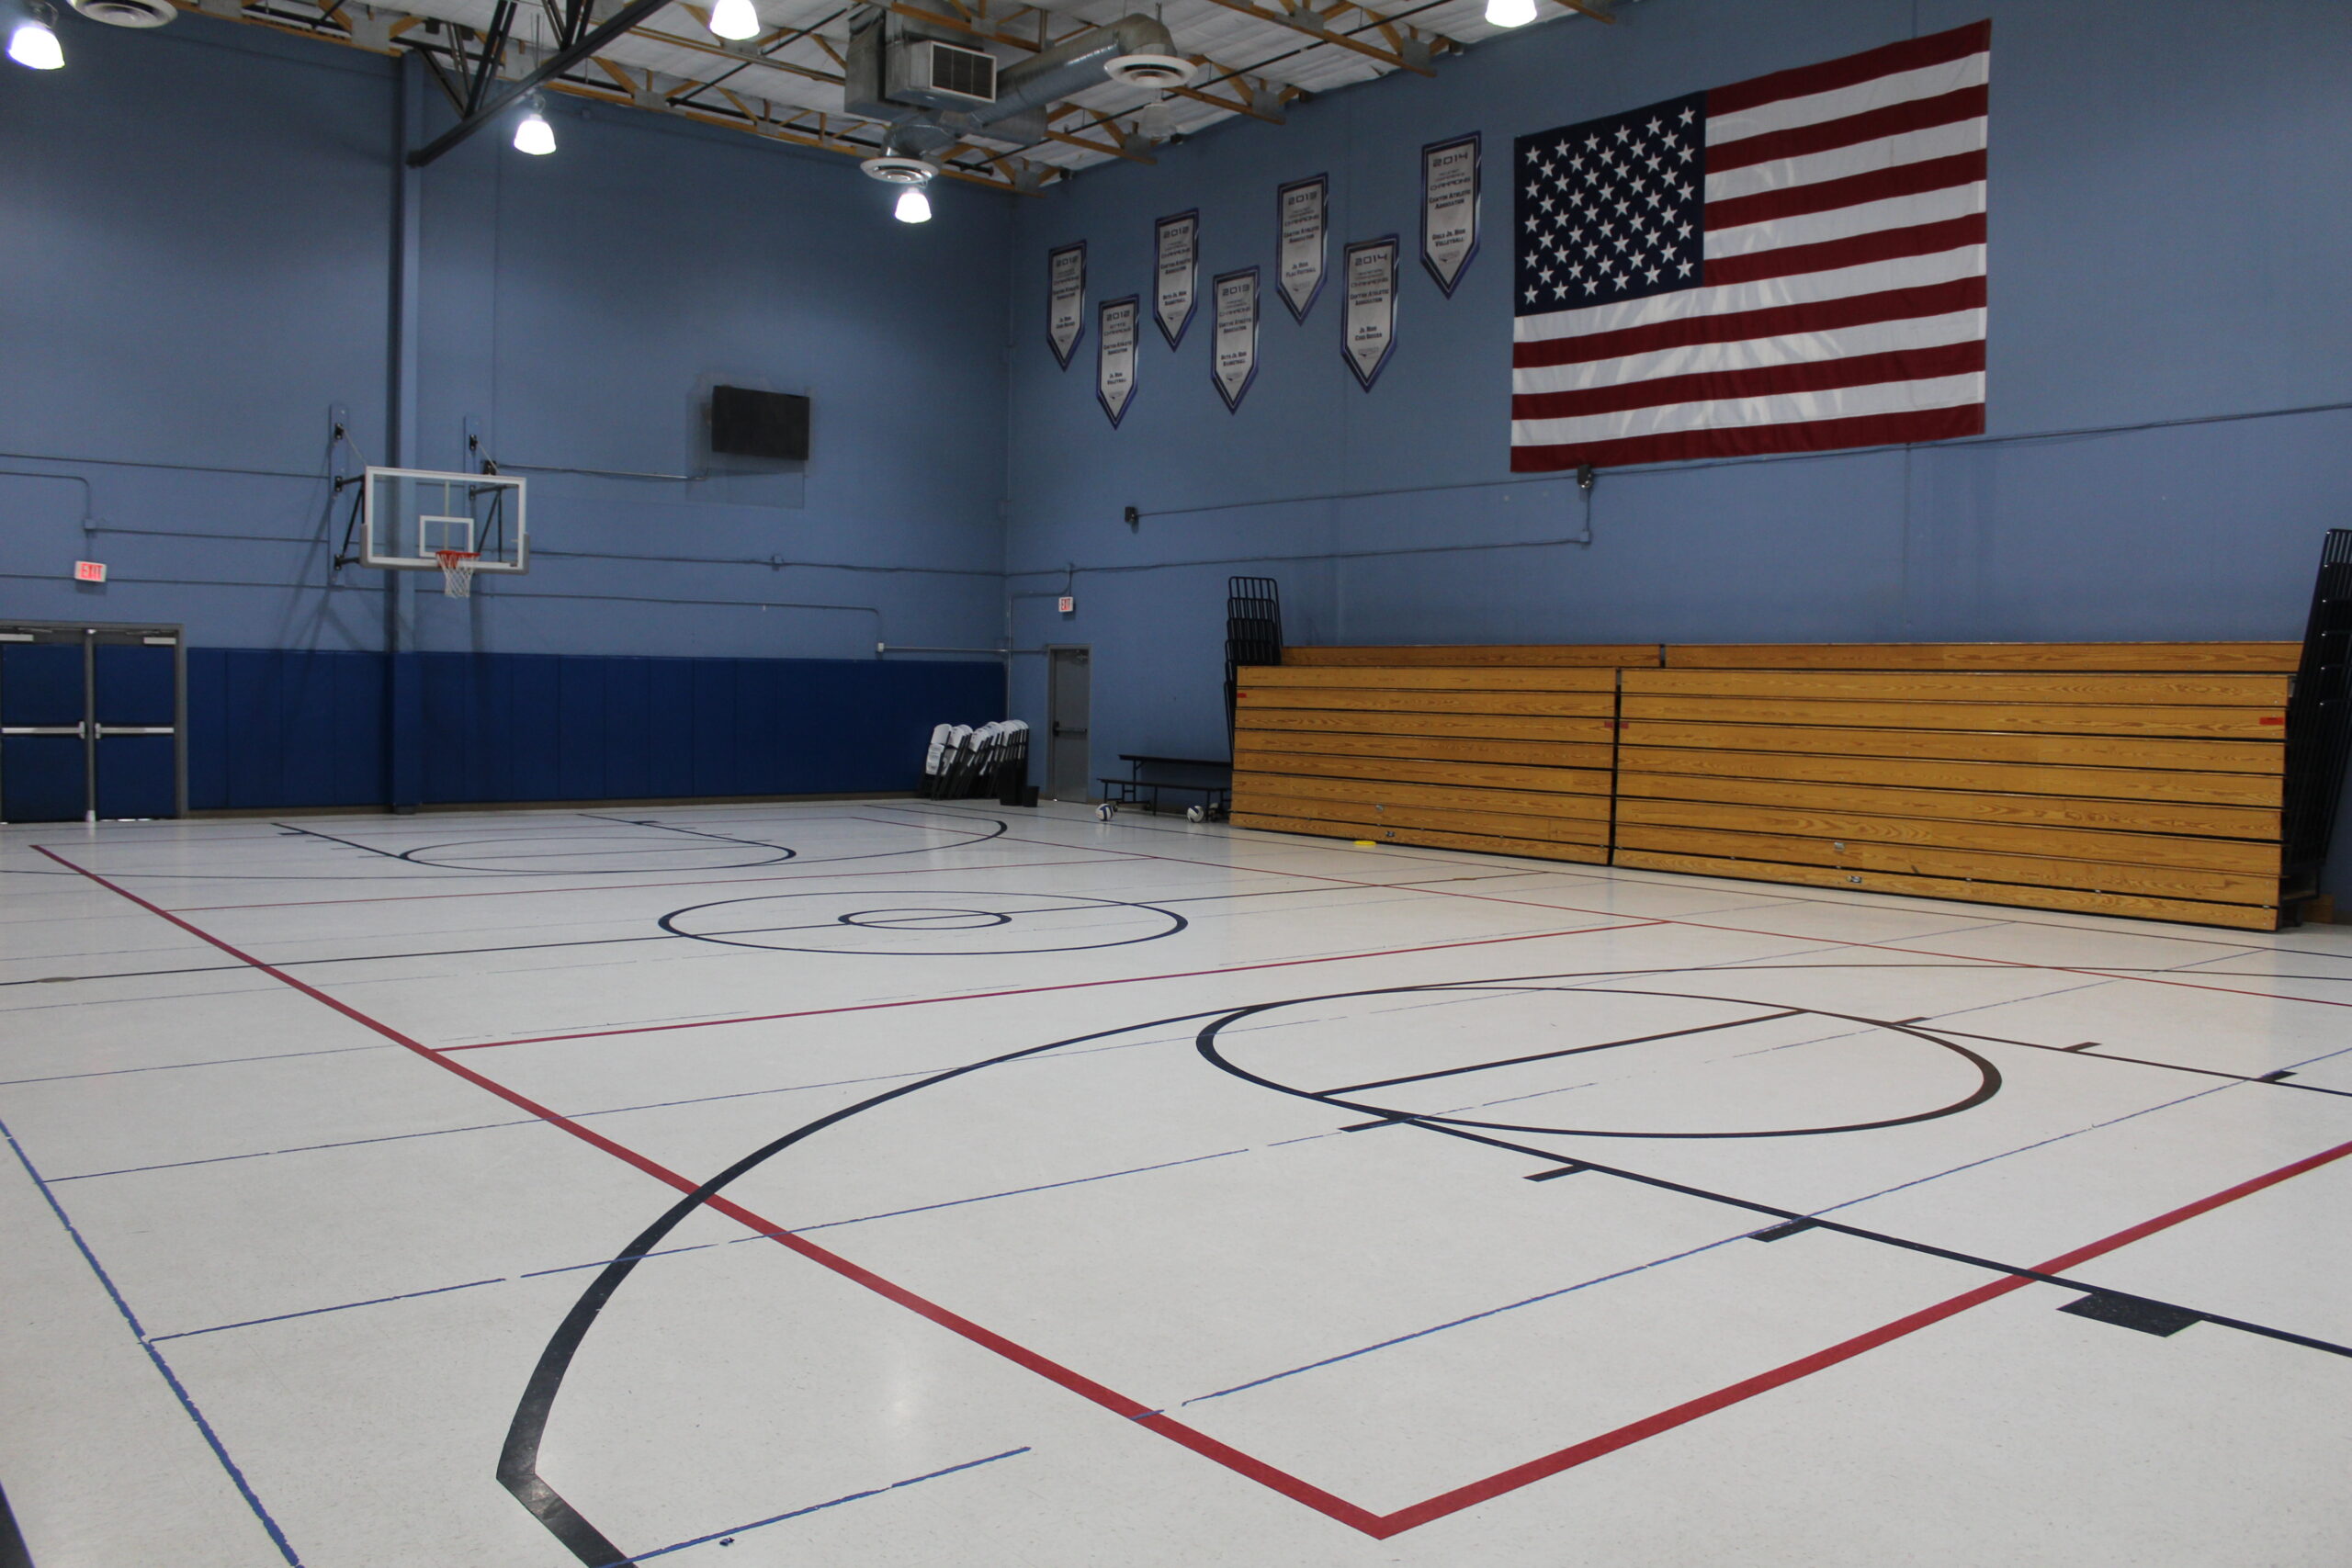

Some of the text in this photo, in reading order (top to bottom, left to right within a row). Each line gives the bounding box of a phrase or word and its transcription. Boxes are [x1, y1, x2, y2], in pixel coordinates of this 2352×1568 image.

[1432, 152, 1468, 167] 2014
[1355, 254, 1387, 265] 2014
[1223, 284, 1250, 296] 2013
[1106, 310, 1130, 321] 2012
[81, 563, 103, 581] EXIT
[1061, 598, 1070, 611] EXIT
